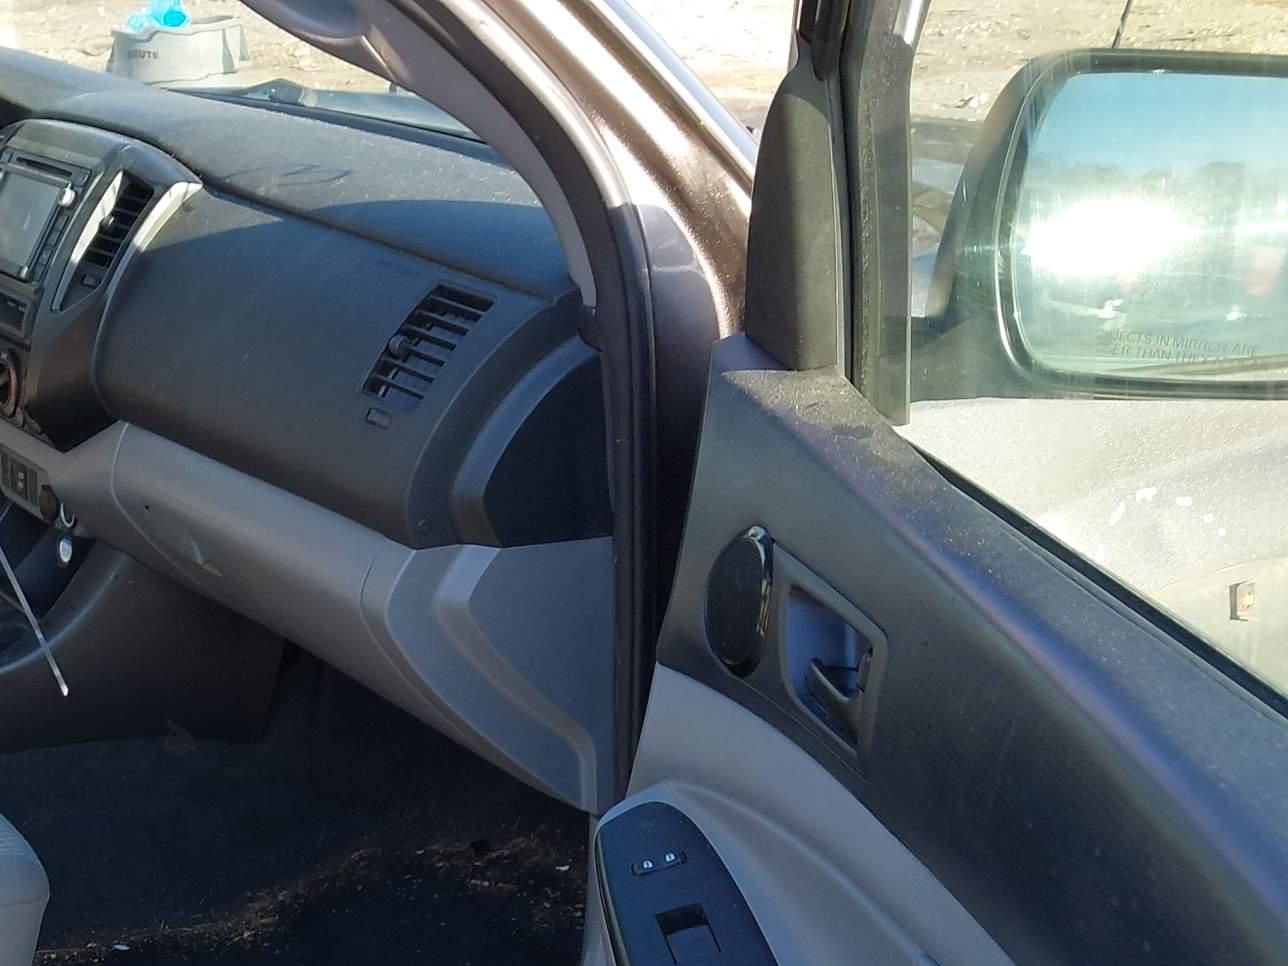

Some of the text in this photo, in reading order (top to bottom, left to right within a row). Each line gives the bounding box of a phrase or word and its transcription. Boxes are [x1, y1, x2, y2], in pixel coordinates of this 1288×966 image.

[1136, 345, 1173, 360] THAN
[1155, 335, 1172, 347] IN
[1173, 336, 1229, 353] MIRROR
[1232, 343, 1258, 357] ARE
